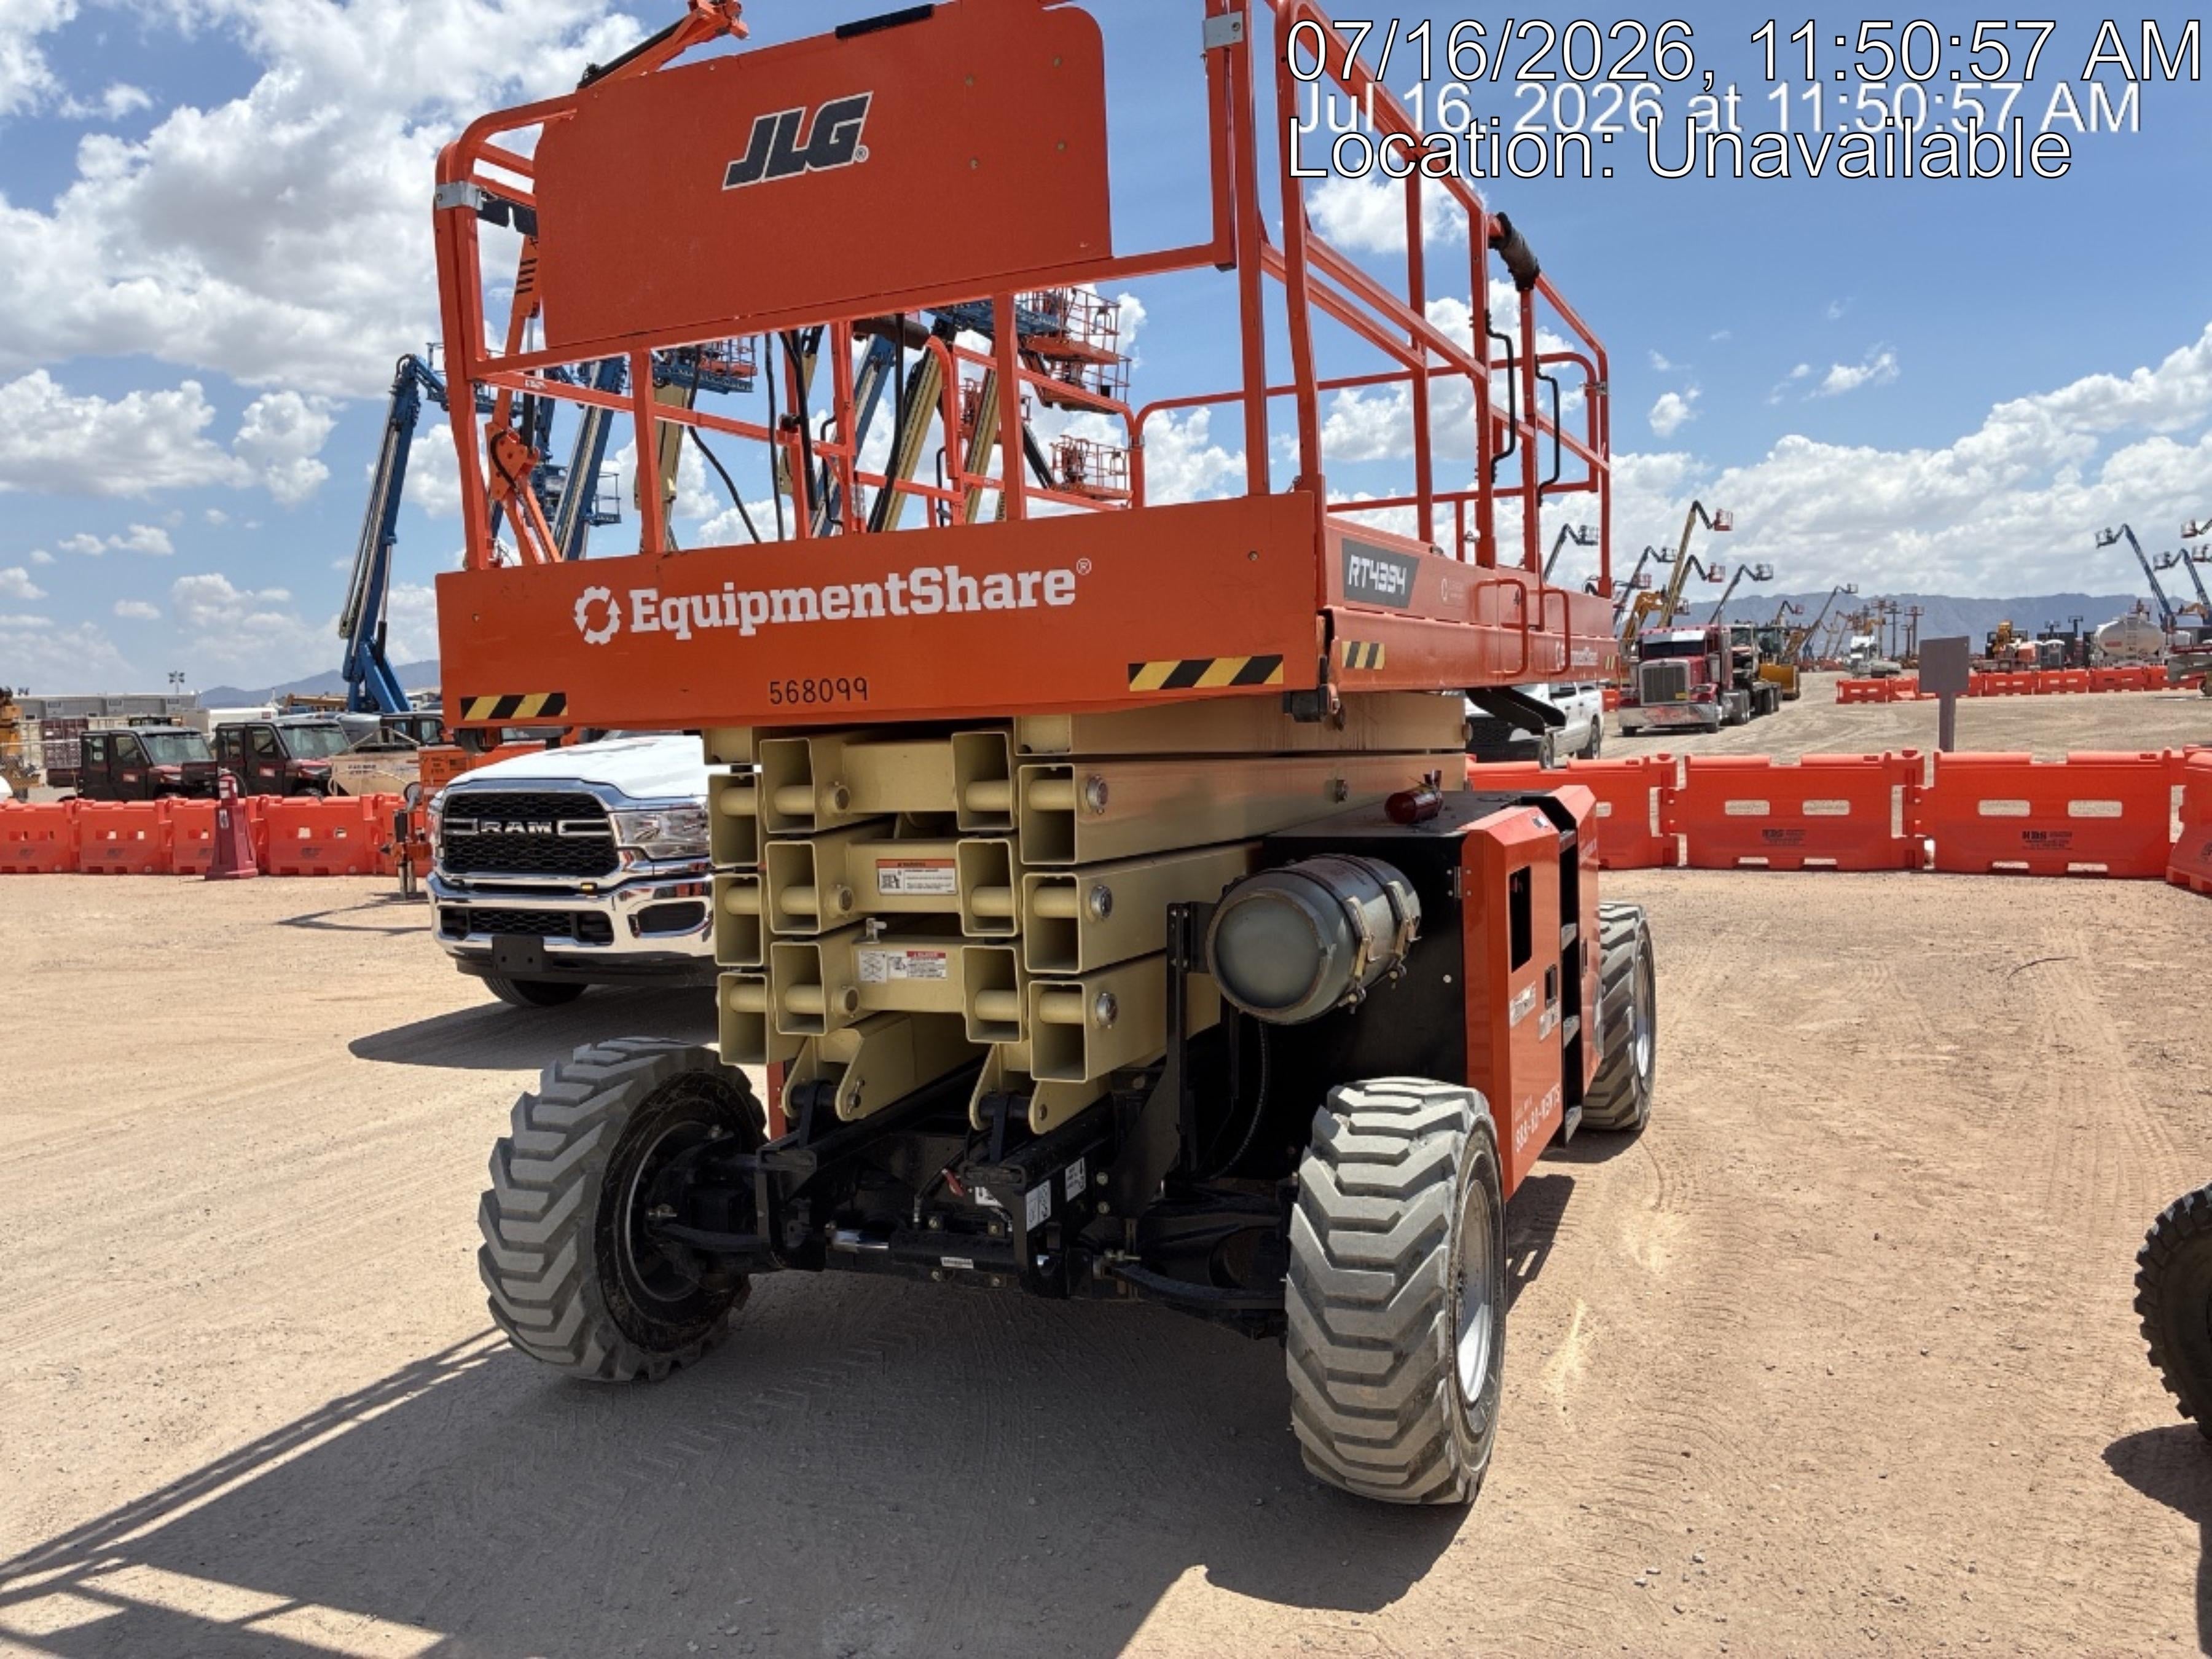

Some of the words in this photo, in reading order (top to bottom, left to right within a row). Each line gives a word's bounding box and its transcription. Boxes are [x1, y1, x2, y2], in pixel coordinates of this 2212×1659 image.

[722, 90, 874, 190] JLG
[629, 565, 1076, 640] EquipmentShare
[770, 677, 868, 704] 568099
[481, 822, 552, 834] RAM
